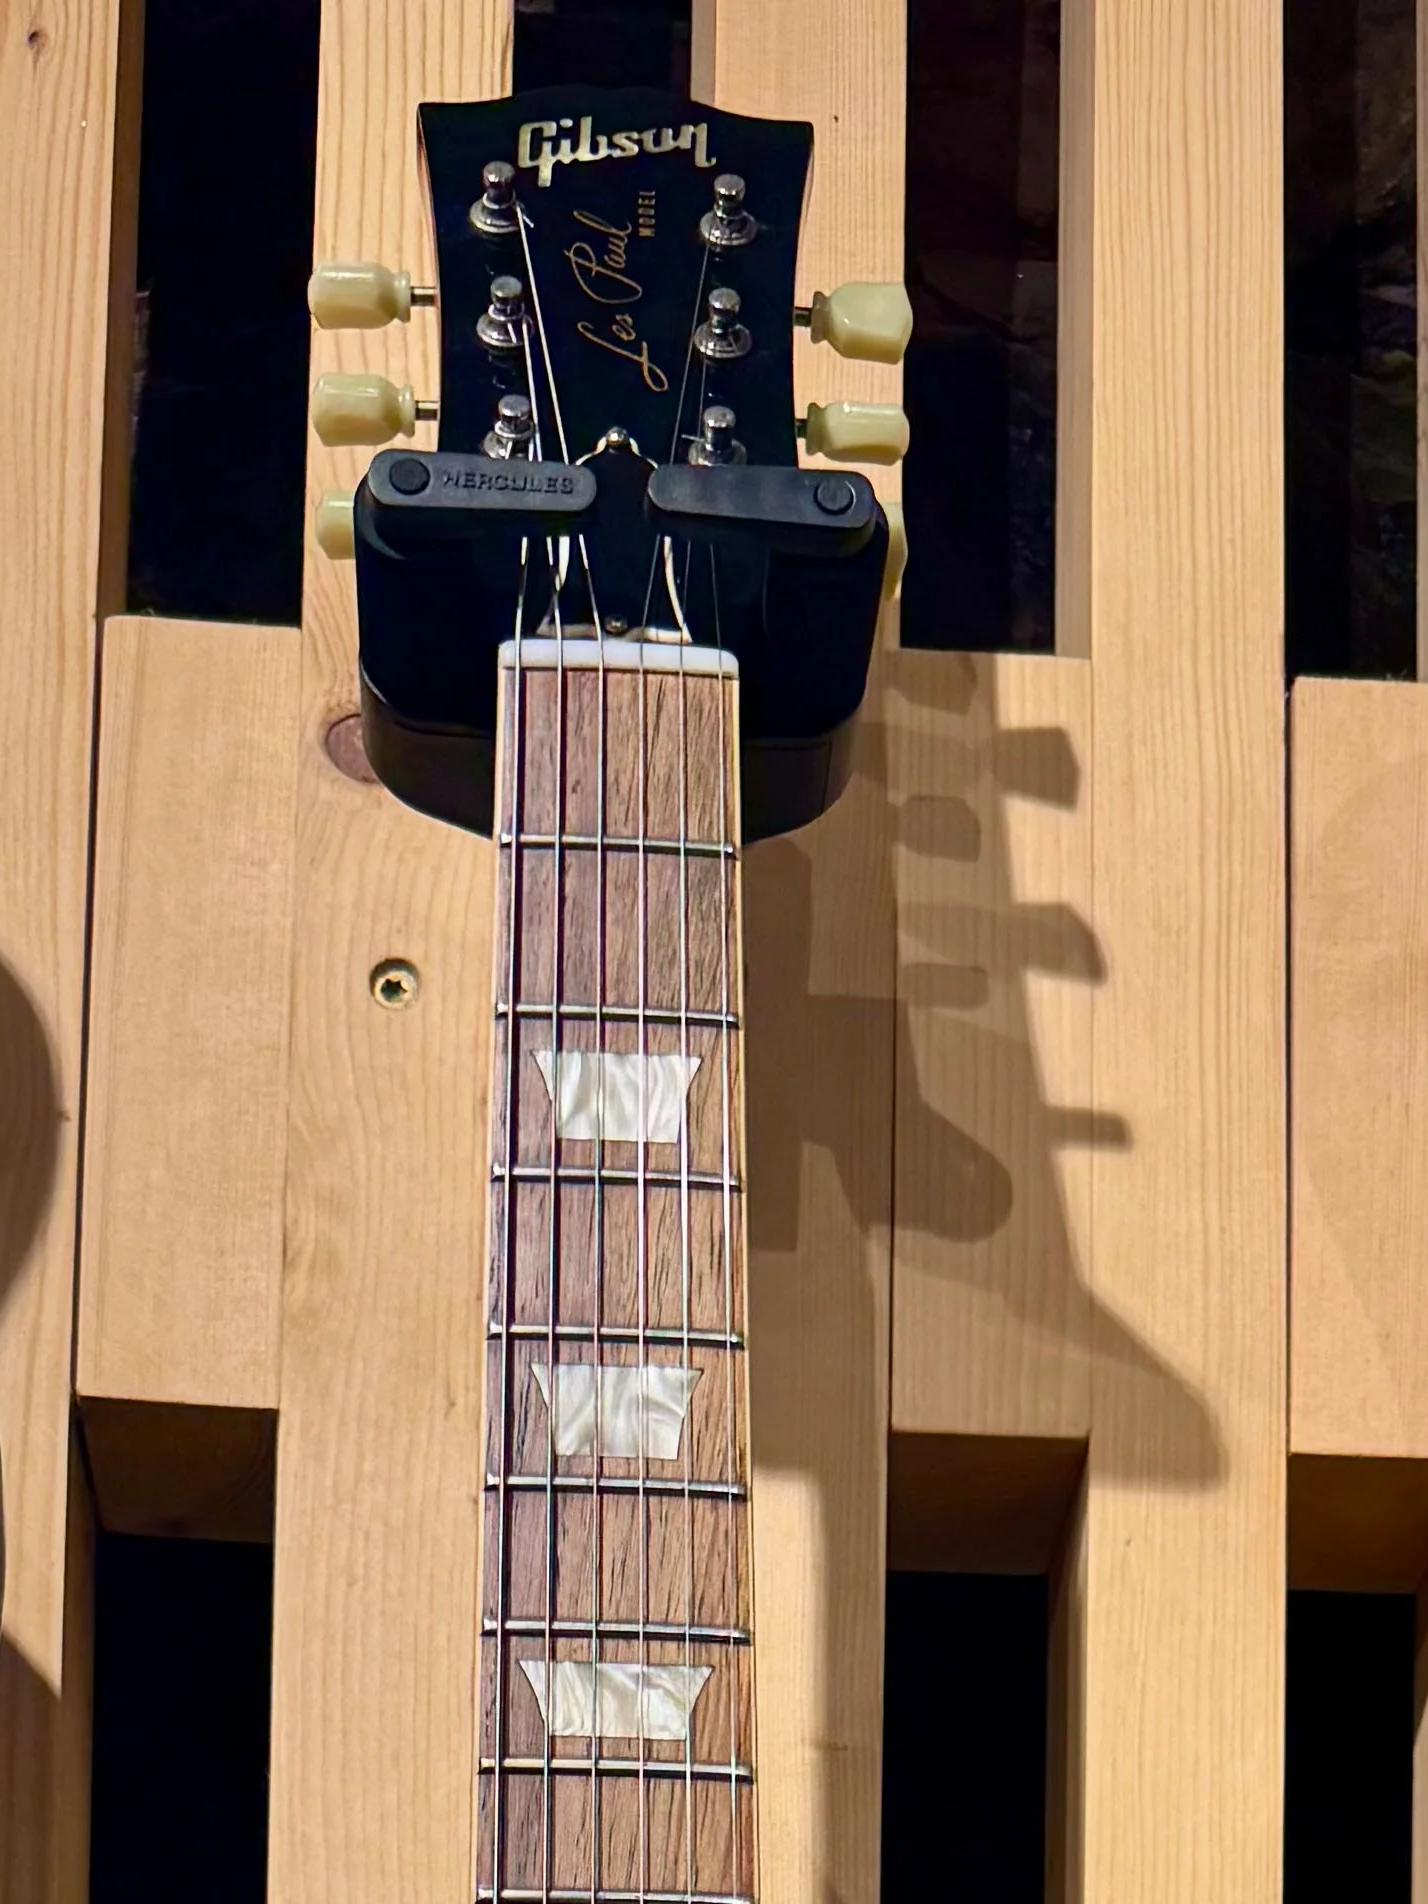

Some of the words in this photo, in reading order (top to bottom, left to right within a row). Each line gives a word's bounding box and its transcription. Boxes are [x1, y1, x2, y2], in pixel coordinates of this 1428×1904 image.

[517, 115, 717, 188] Gibson
[638, 190, 656, 237] MODEL
[563, 209, 643, 304] Paul
[576, 313, 669, 392] Les
[443, 471, 573, 495] HERCULES
